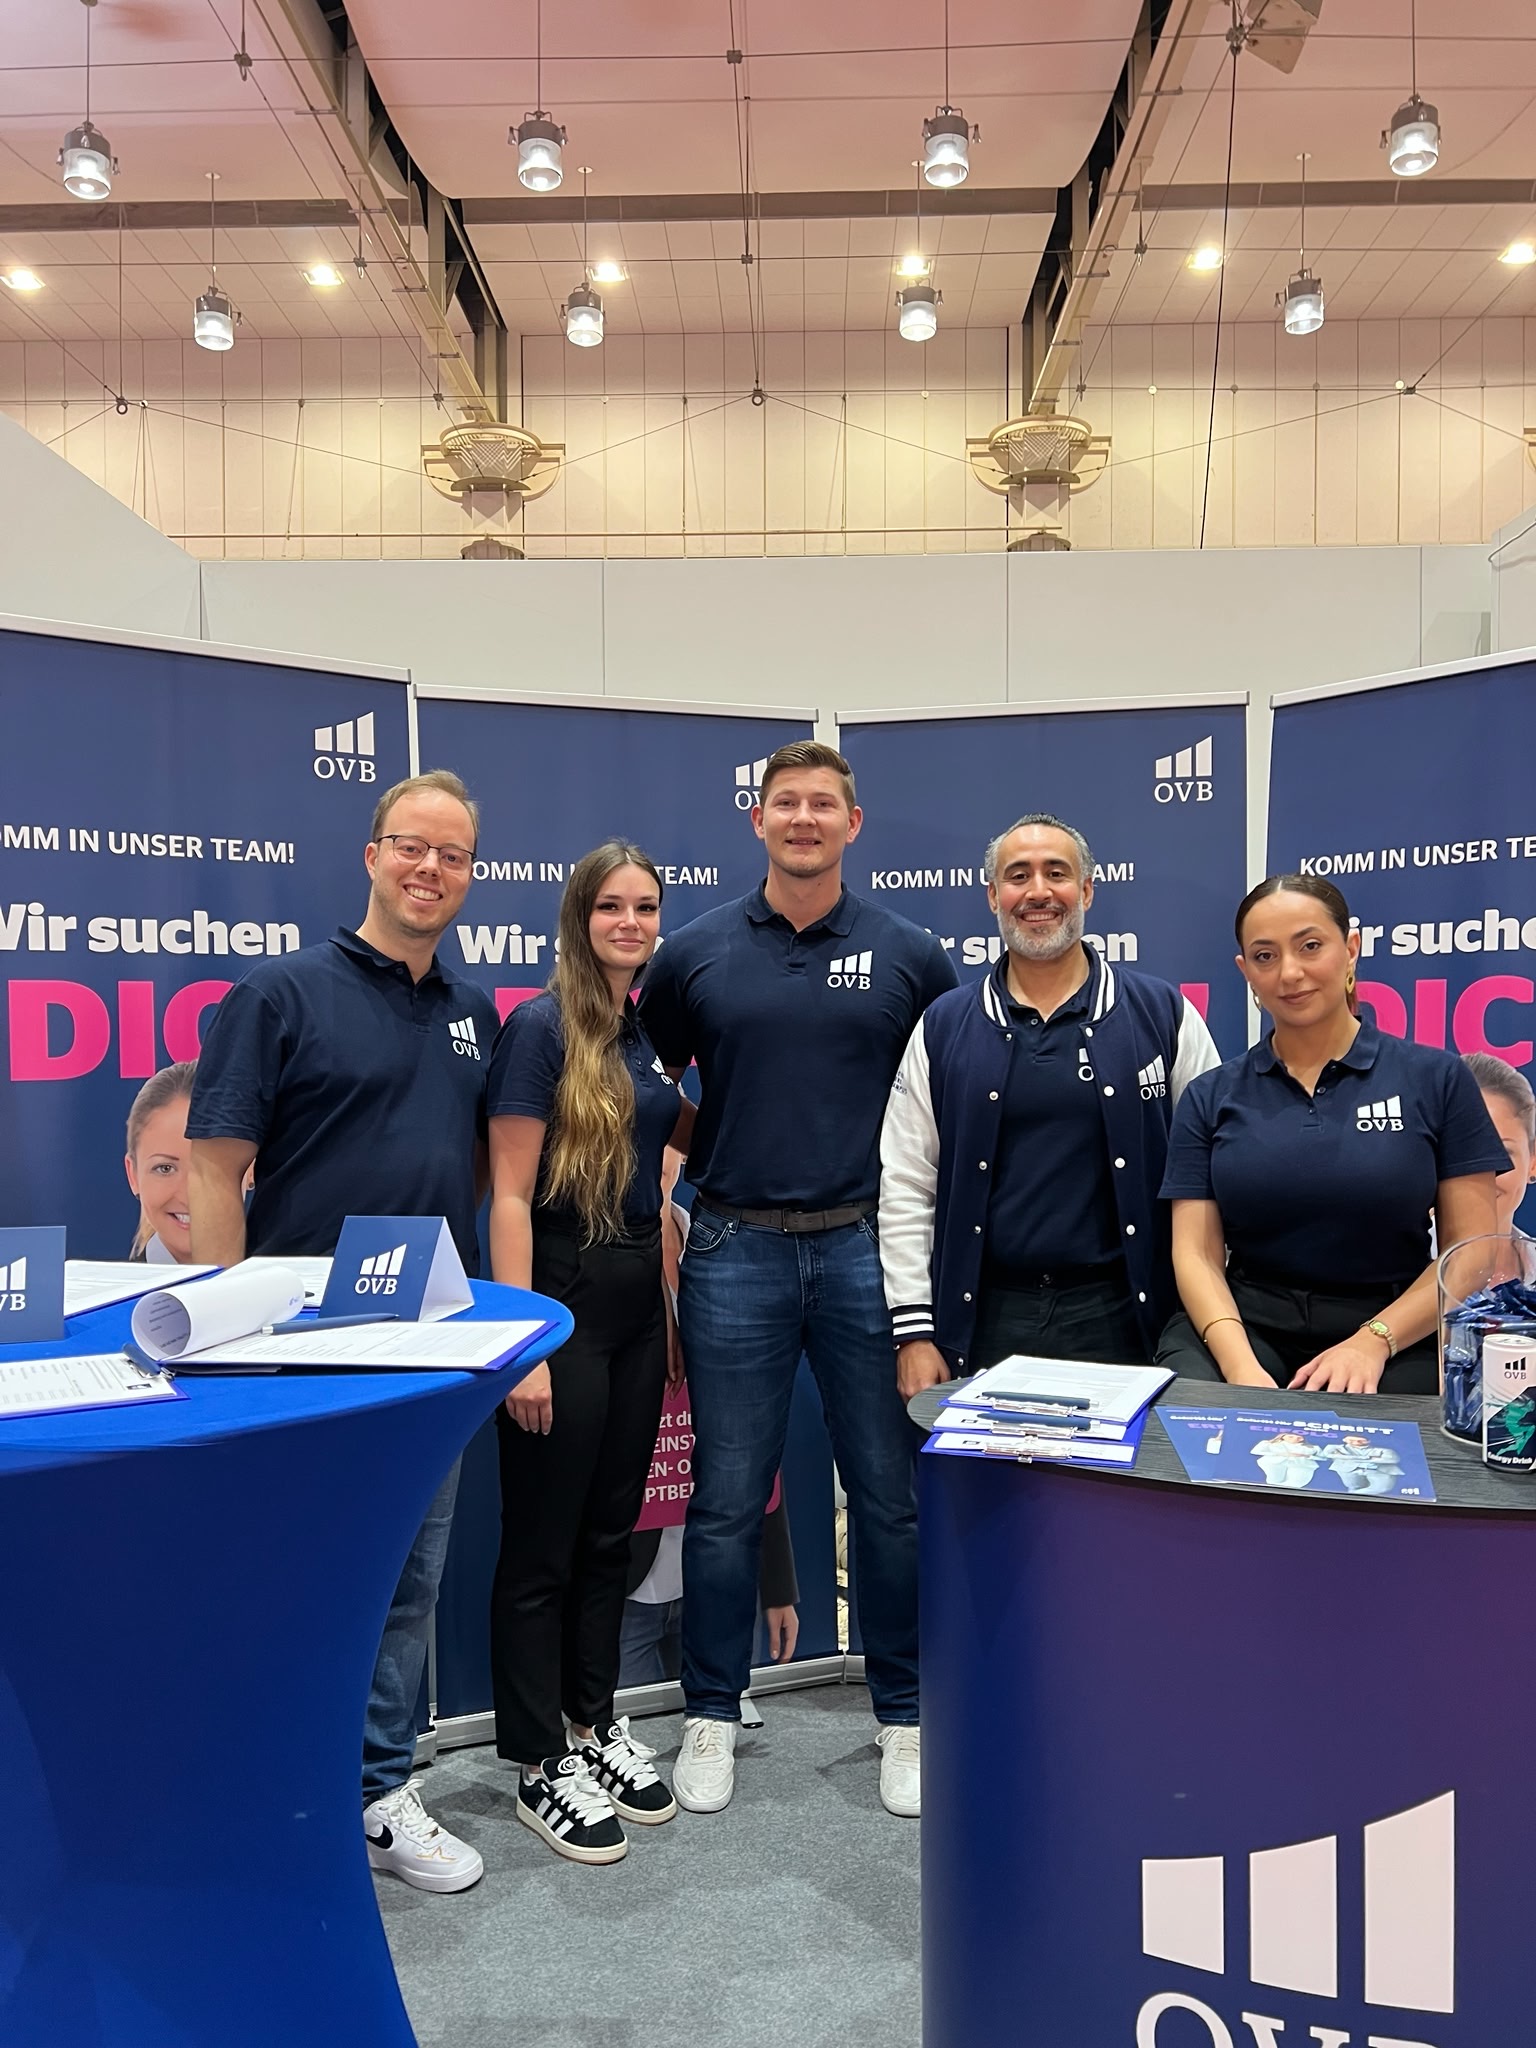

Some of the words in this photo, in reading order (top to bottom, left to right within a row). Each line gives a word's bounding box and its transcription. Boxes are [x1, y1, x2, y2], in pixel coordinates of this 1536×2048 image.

[313, 756, 377, 783] OVB
[1154, 782, 1214, 803] OVB
[0, 824, 59, 851] MM
[69, 828, 99, 853] IN
[108, 831, 203, 859] UNSER
[210, 837, 295, 864] TEAM!
[1300, 851, 1374, 877] KOMM
[1381, 847, 1406, 870] IN
[1413, 839, 1498, 867] UNSER
[472, 861, 533, 881] OMM
[540, 863, 563, 882] IN
[871, 869, 943, 889] KOMM
[950, 868, 973, 887] IN
[1092, 863, 1134, 882] AM!
[88, 910, 300, 956] suchen
[457, 924, 547, 964] Wir
[827, 974, 871, 990] OVB
[453, 1040, 480, 1060] OVB
[1140, 1084, 1166, 1100] OVB
[1356, 1119, 1404, 1132] OVB
[354, 1278, 397, 1295] OVB
[1504, 1371, 1527, 1380] OVB
[659, 1413, 673, 1429] zt
